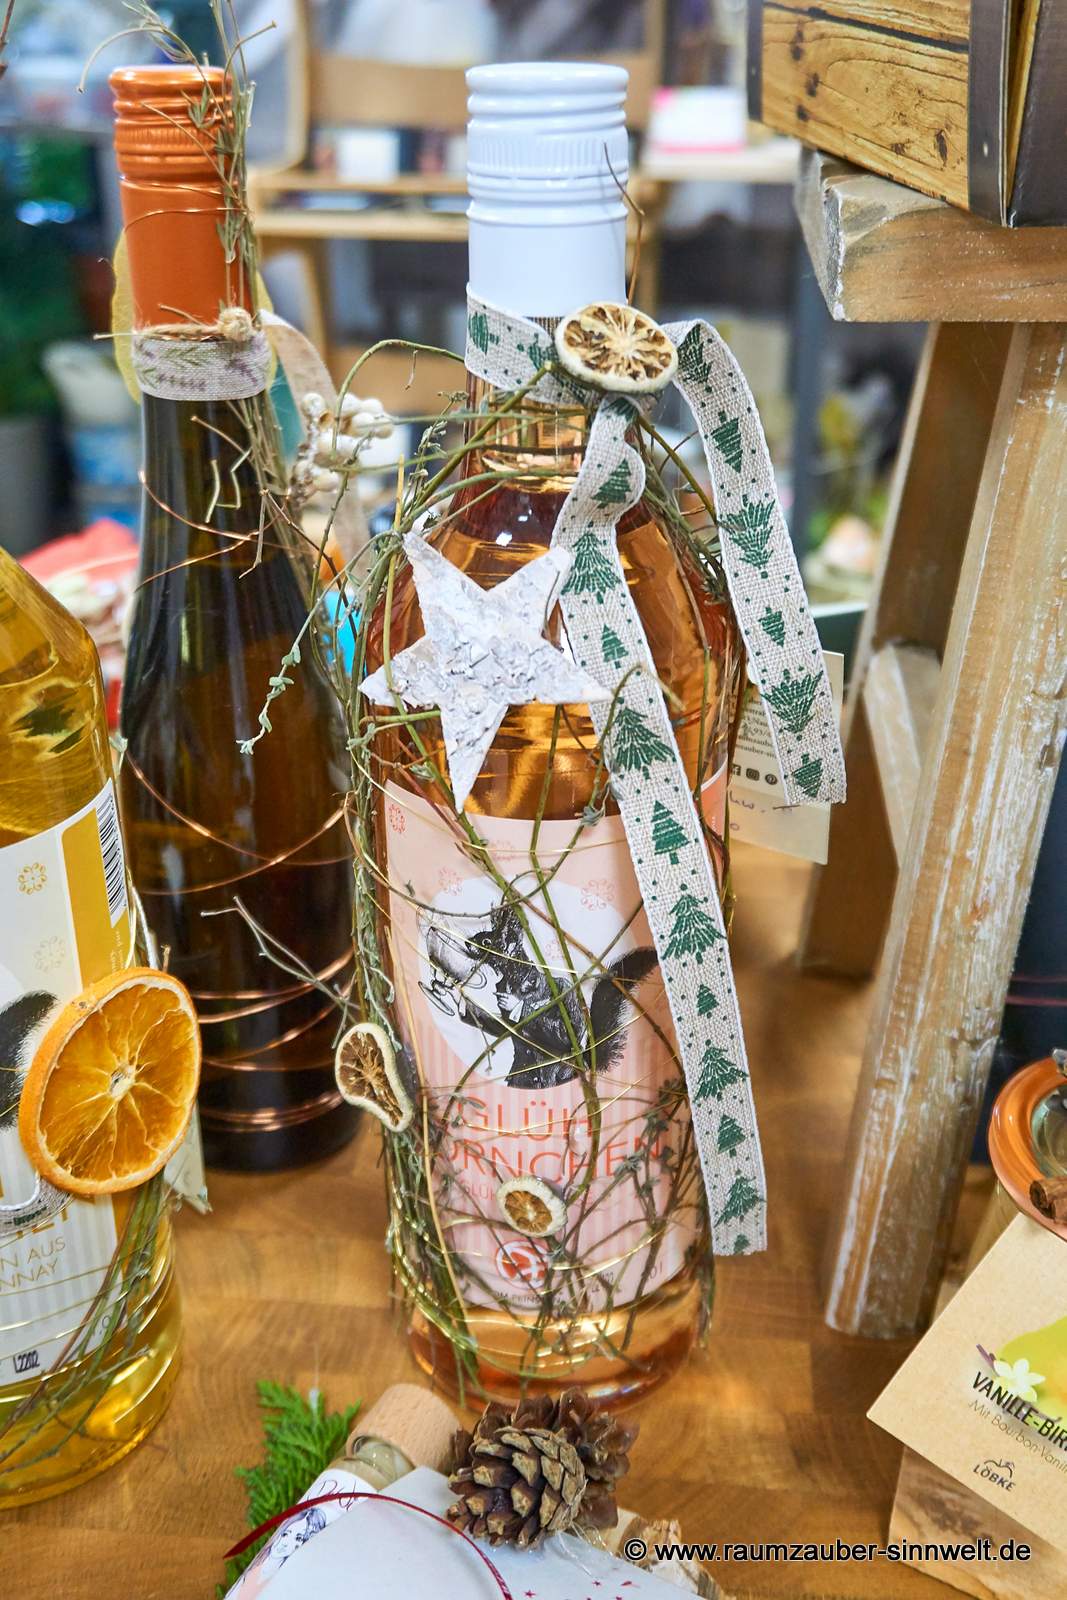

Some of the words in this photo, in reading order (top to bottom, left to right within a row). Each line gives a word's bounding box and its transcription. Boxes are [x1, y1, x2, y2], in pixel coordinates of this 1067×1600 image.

[26, 1236, 66, 1264] AUS
[968, 1399, 991, 1420] Mit
[971, 1370, 1067, 1452] VANILLE-BIR
[973, 1463, 1017, 1492] LÖBKE
